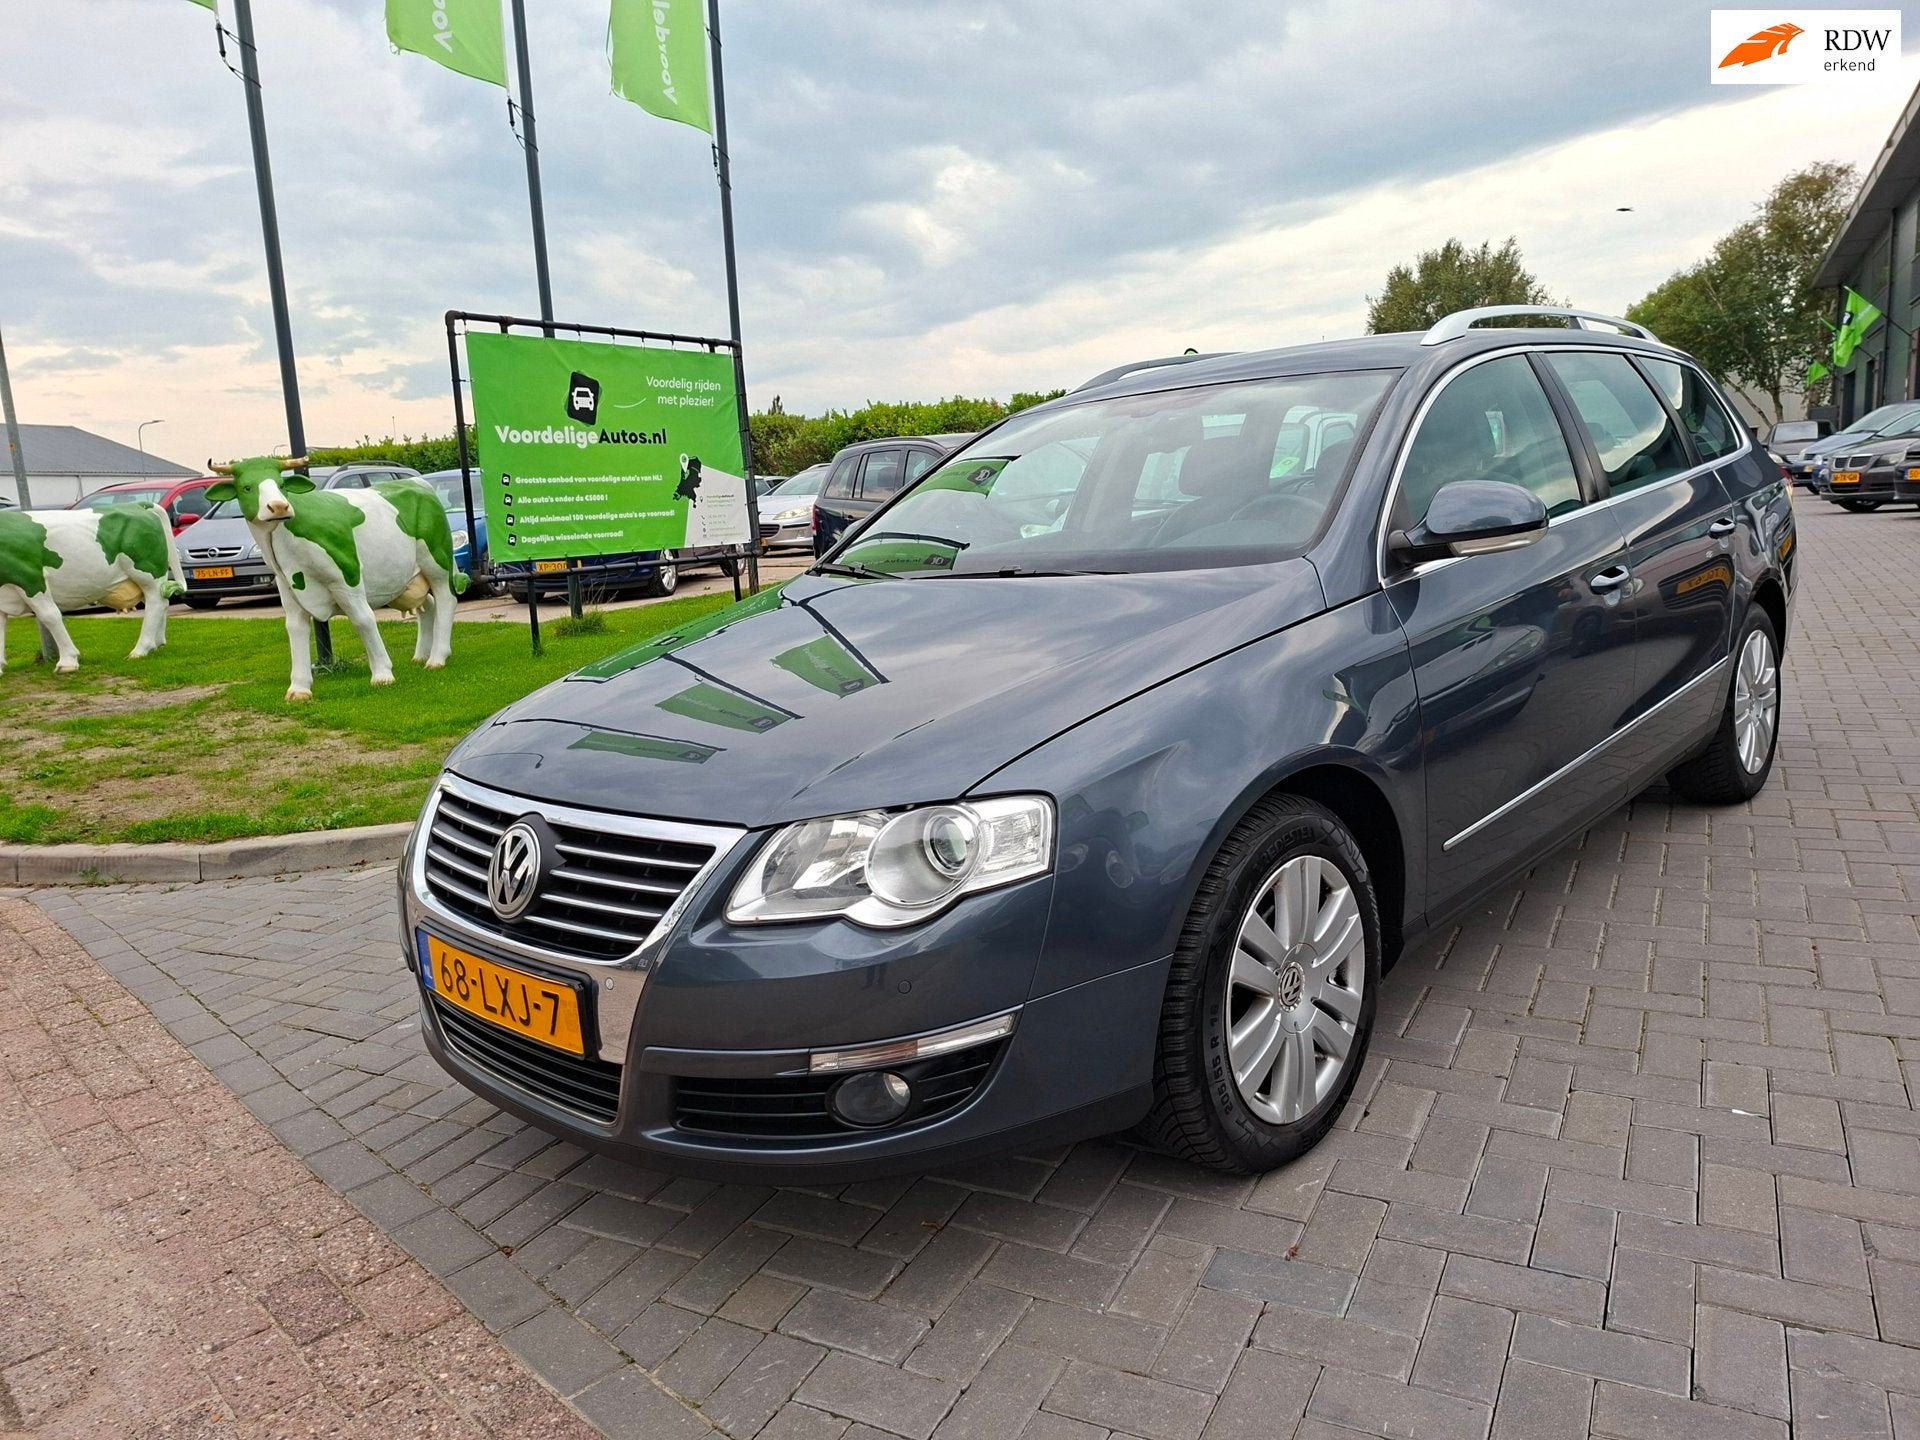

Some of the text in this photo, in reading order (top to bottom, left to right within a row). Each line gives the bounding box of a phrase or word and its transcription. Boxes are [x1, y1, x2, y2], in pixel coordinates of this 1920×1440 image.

[646, 376, 721, 393] Voordelig rijden
[657, 394, 714, 408] met plezier!
[494, 425, 667, 449] VoordeligeAutos.nl
[588, 475, 621, 483] voordelige
[518, 496, 531, 504] Alle
[520, 515, 539, 524] Altijd
[540, 514, 571, 523] minimaal
[585, 512, 618, 520] voordelige
[619, 511, 637, 519] auto's
[521, 535, 554, 544] Dagelijks
[555, 532, 592, 541] wisselende
[440, 951, 560, 1036] 68-LXJ-7
[1210, 1035, 1220, 1049] R
